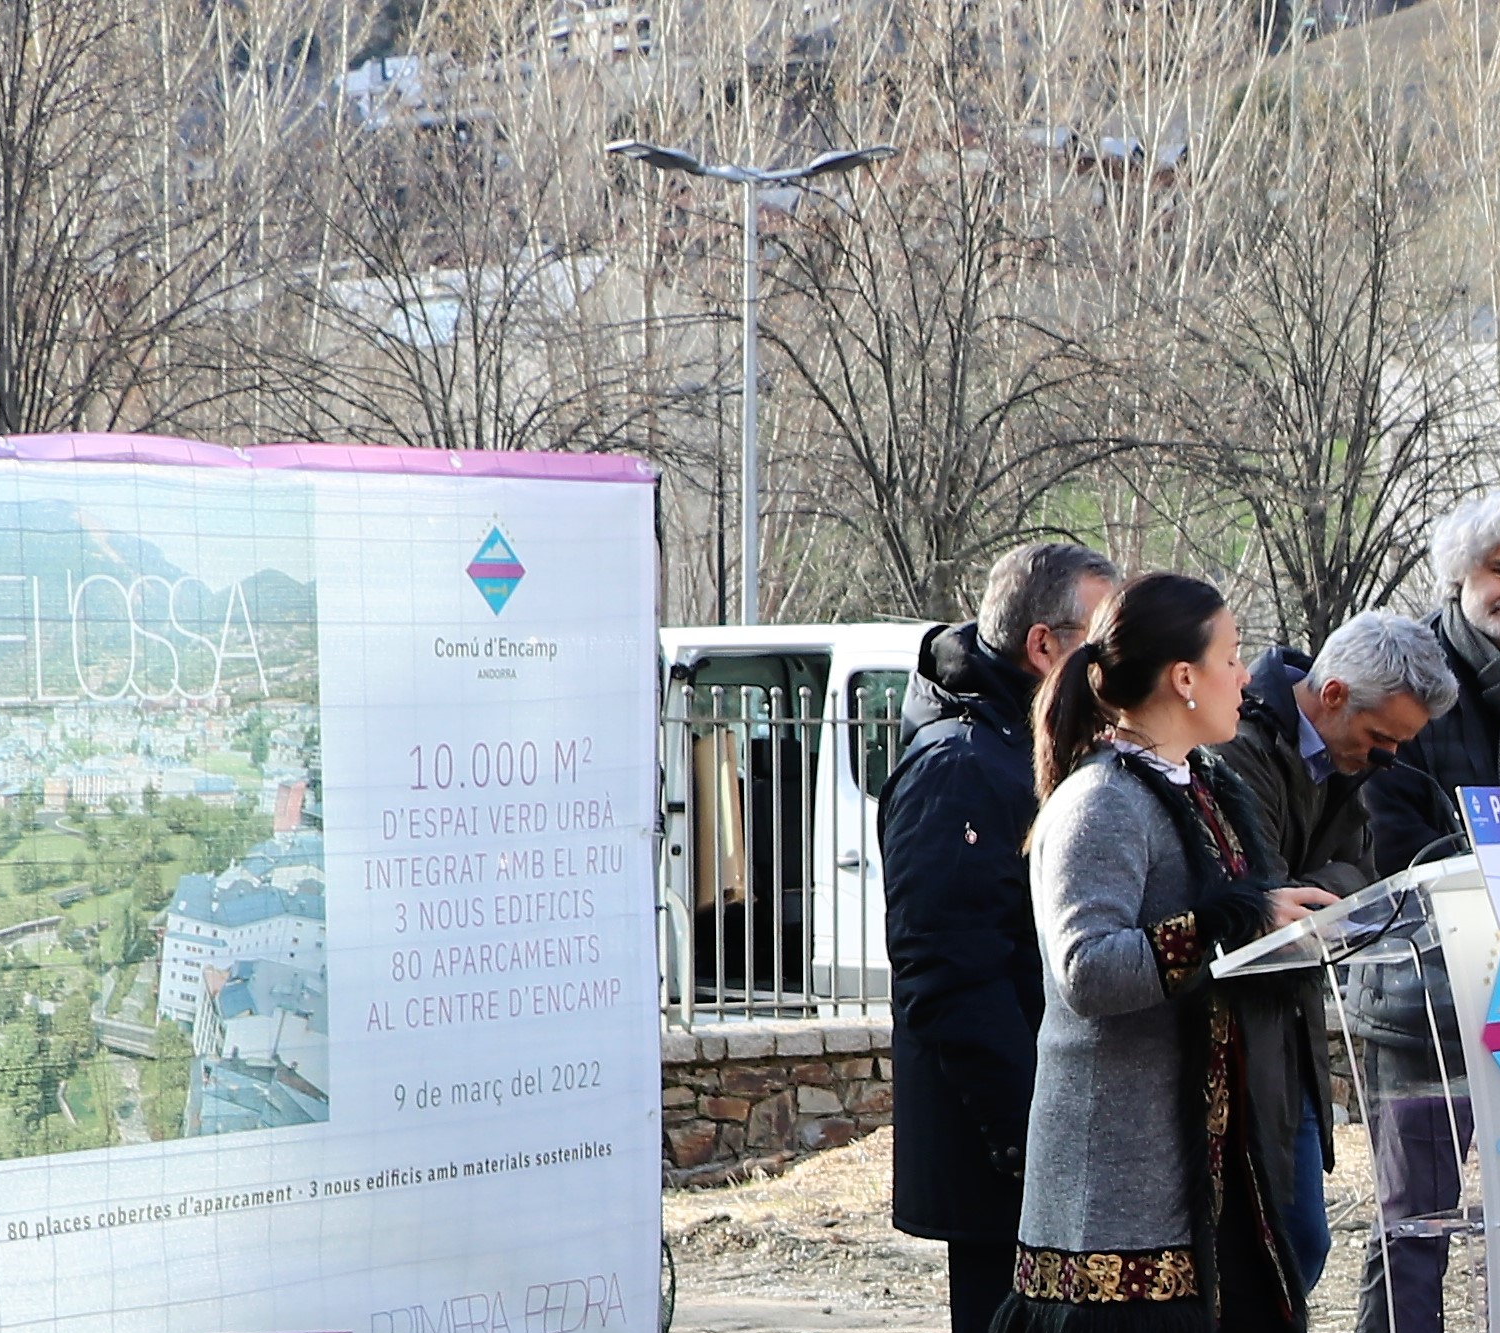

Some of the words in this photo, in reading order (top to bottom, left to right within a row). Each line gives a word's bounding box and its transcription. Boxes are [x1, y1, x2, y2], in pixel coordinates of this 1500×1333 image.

[434, 636, 479, 658] Comú
[484, 637, 558, 661] d'Encamp
[477, 668, 517, 680] ANDORRA
[408, 741, 538, 790] 10.000
[382, 806, 479, 841] D'ESPAI
[489, 802, 548, 834] VERD
[556, 791, 615, 831] URBÀ
[364, 853, 487, 890] INTEGRAT
[496, 850, 544, 881] AMB
[555, 848, 577, 877] EL
[586, 845, 623, 875] RIU
[395, 902, 408, 934] 3
[419, 897, 485, 932] NOUS
[495, 889, 596, 926] EDIFICIS
[392, 949, 422, 983] 80
[432, 934, 601, 978] APARCAMENTS
[366, 1001, 395, 1032] AL
[405, 990, 499, 1029] CENTRE
[509, 978, 622, 1018] D'ENCAMP
[394, 1083, 406, 1112] 9
[416, 1080, 442, 1110] de
[451, 1078, 503, 1106] març
[511, 1067, 542, 1098] del
[551, 1060, 601, 1093] 2022
[7, 1220, 30, 1243] 80
[35, 1211, 92, 1242] places
[98, 1200, 173, 1229] cobertes
[178, 1185, 294, 1218] d'aparcament
[309, 1180, 319, 1200] 3
[324, 1177, 362, 1197] nous
[366, 1166, 423, 1191] edificis
[427, 1160, 459, 1182] amb
[463, 1152, 532, 1178] materials
[535, 1139, 614, 1168] sostenibles
